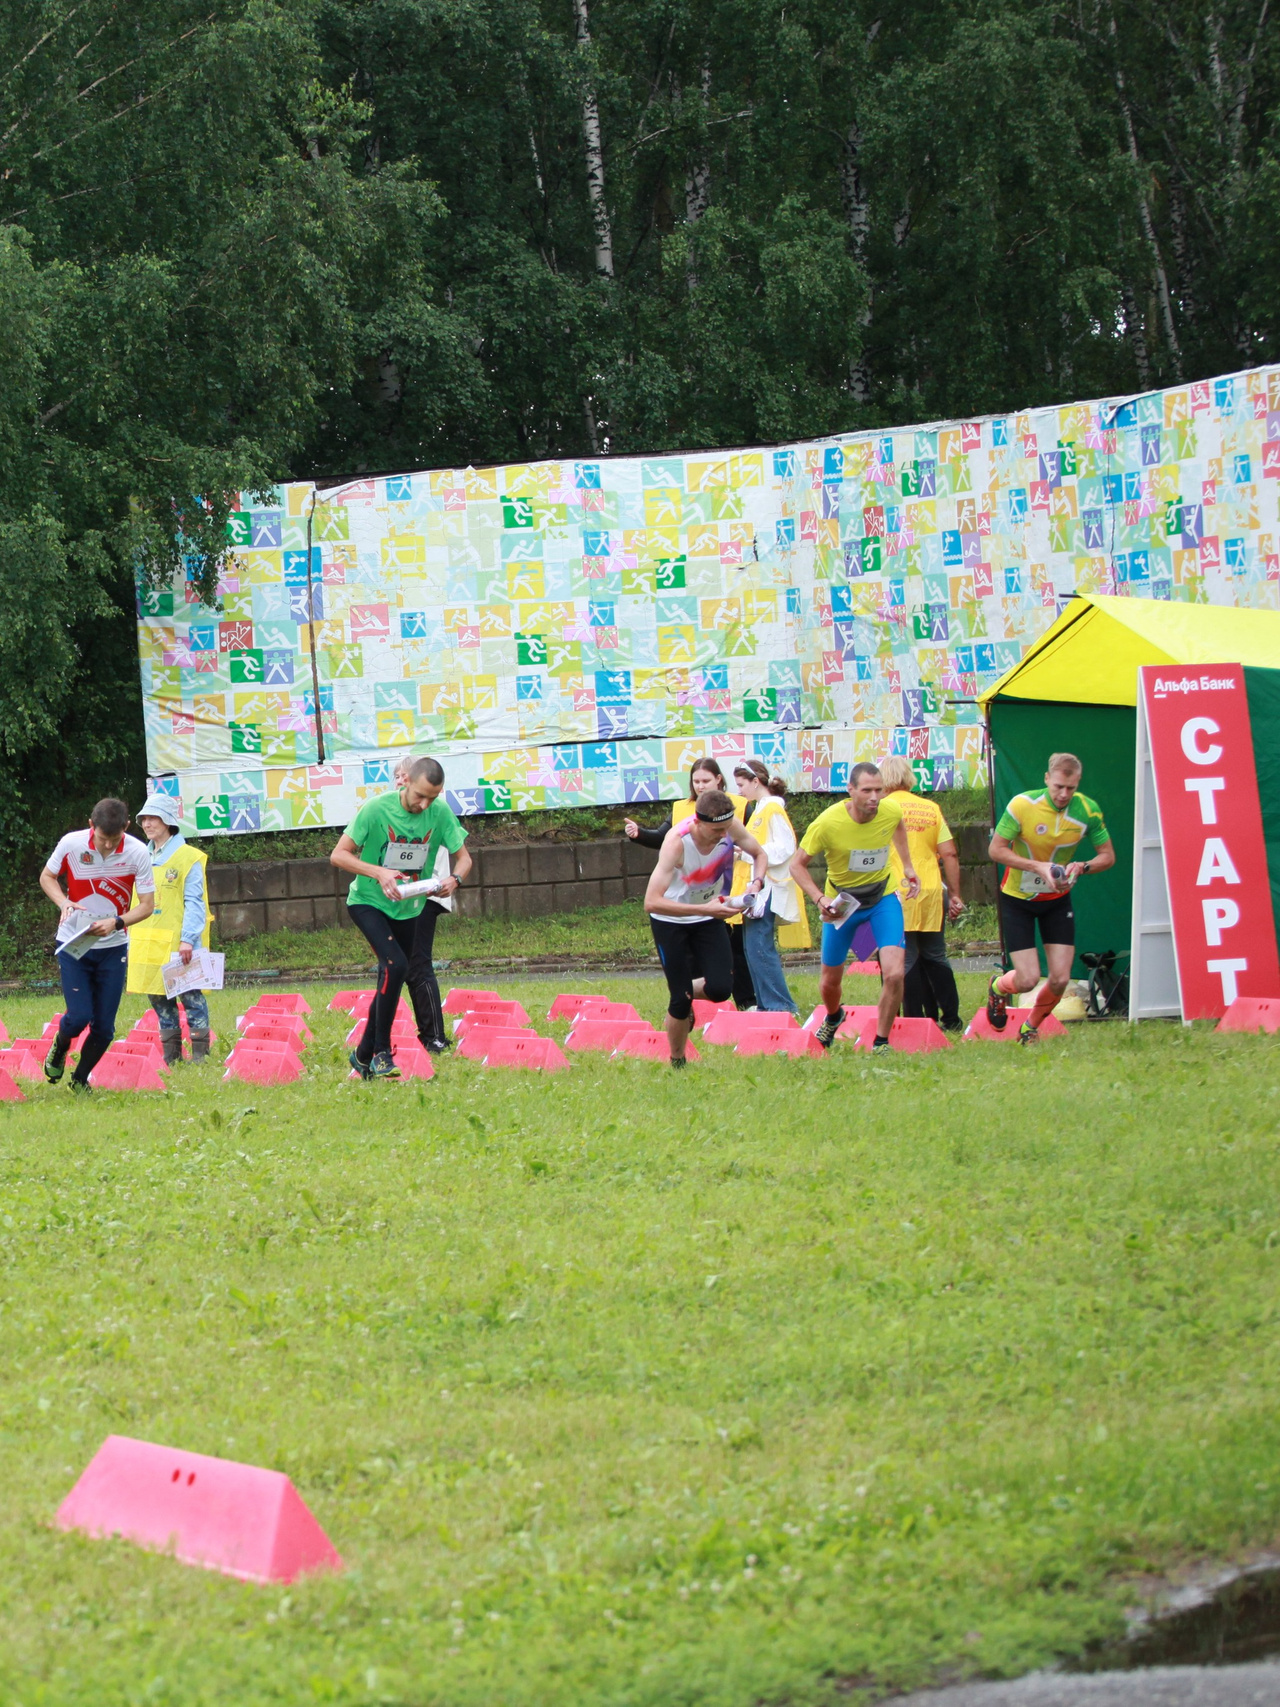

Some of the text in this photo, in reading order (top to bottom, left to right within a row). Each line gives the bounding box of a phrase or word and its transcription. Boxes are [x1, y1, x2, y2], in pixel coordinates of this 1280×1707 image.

[1153, 676, 1236, 694] Альфа Банк
[400, 851, 413, 860] 66
[862, 857, 875, 865] 63
[1180, 717, 1247, 1006] СТАРТ
[98, 881, 117, 896] Run
[703, 889, 715, 900] 64
